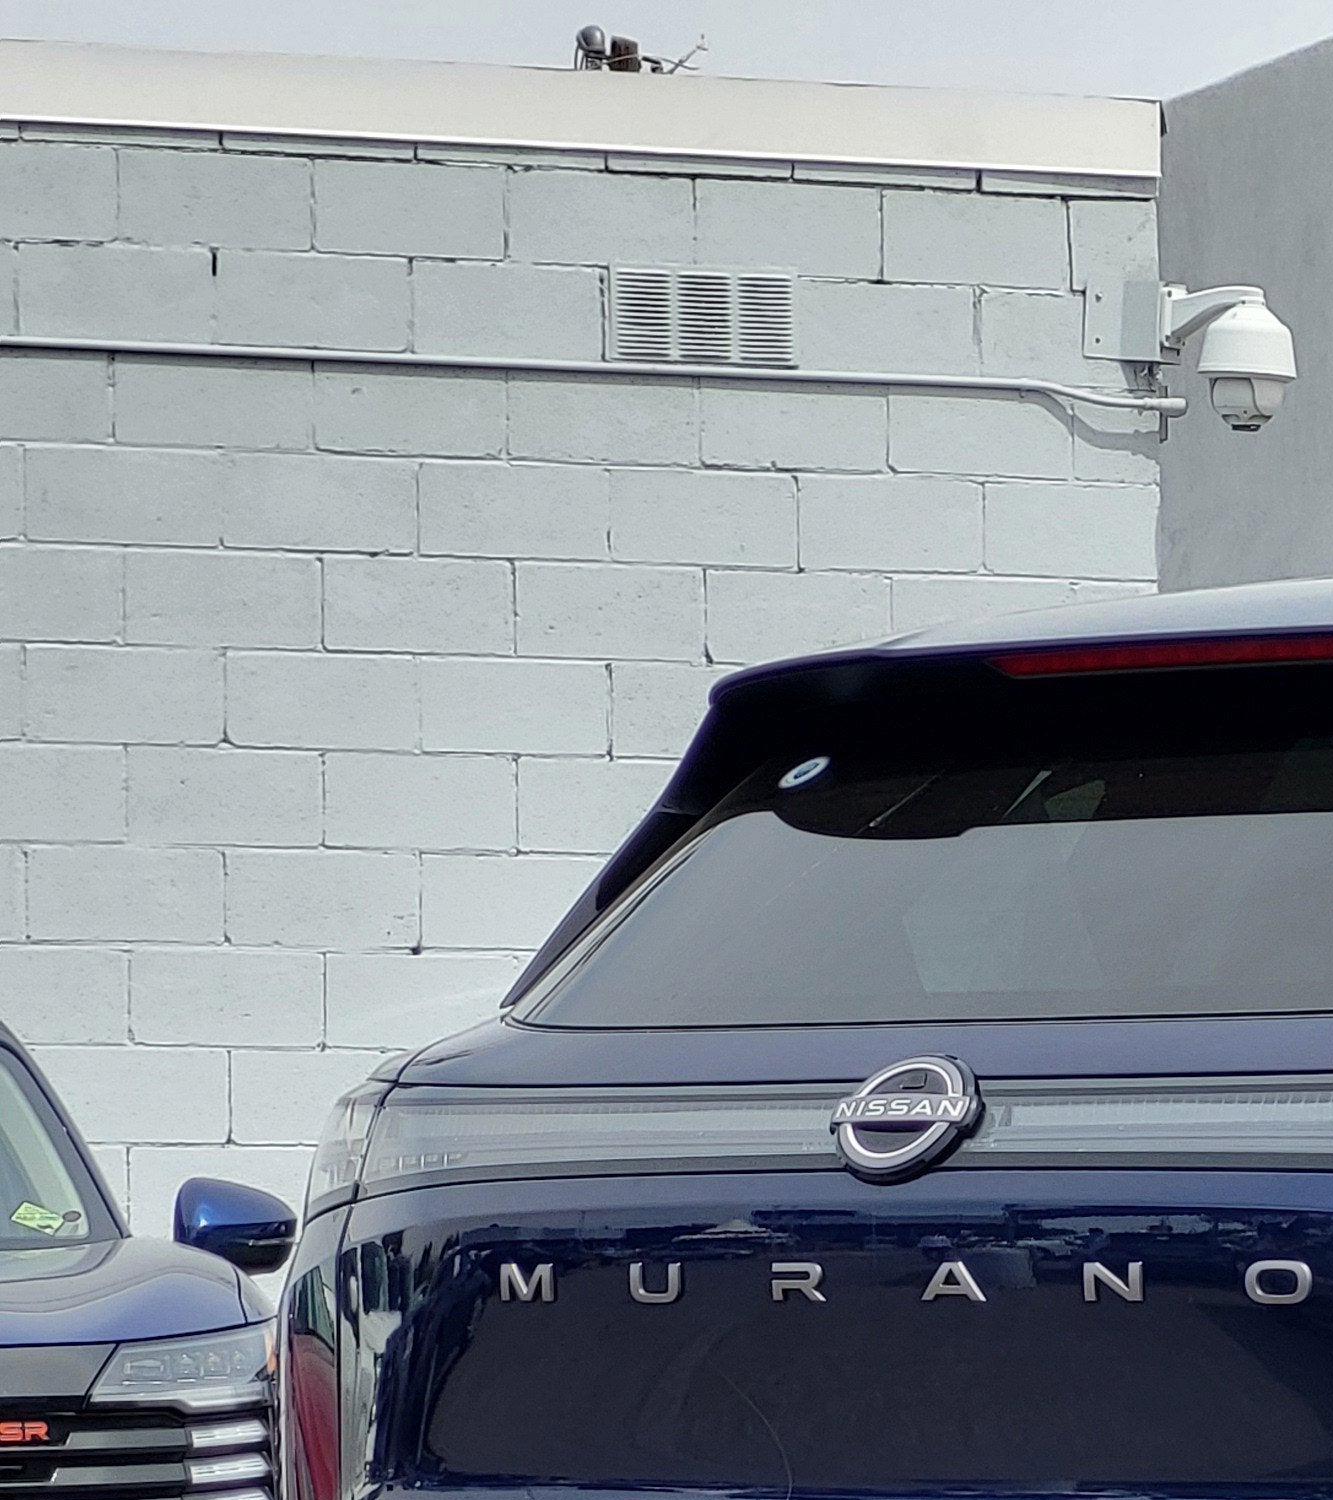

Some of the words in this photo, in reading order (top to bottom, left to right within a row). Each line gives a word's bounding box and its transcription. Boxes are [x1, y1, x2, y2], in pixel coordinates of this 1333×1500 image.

[835, 1099, 964, 1118] NISSAN
[500, 1260, 1313, 1305] MURANO
[0, 1421, 49, 1441] SR
